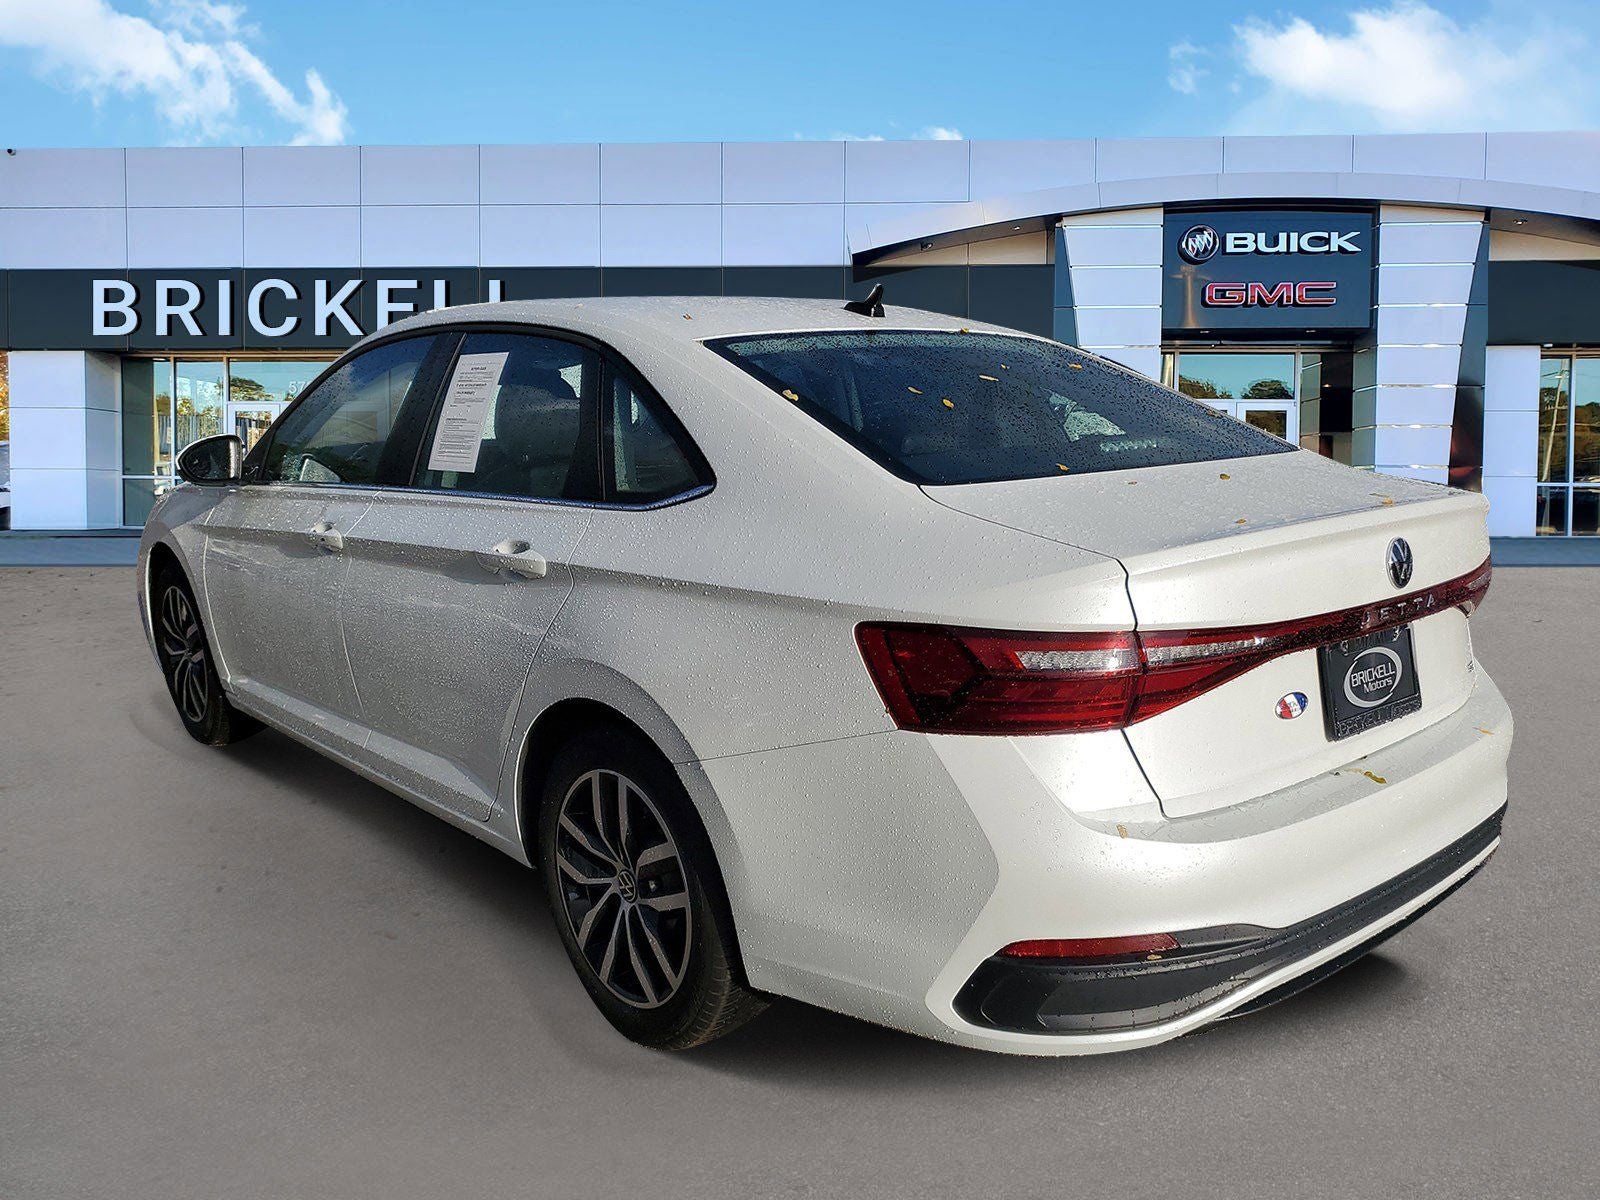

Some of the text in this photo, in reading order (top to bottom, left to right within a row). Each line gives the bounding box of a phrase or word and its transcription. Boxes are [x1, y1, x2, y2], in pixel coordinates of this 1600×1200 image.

[1225, 231, 1362, 253] BUICK
[1205, 281, 1337, 305] GMC
[1361, 594, 1435, 627] JETTA
[1351, 662, 1396, 687] BRICKELL
[1363, 676, 1393, 693] Motors
